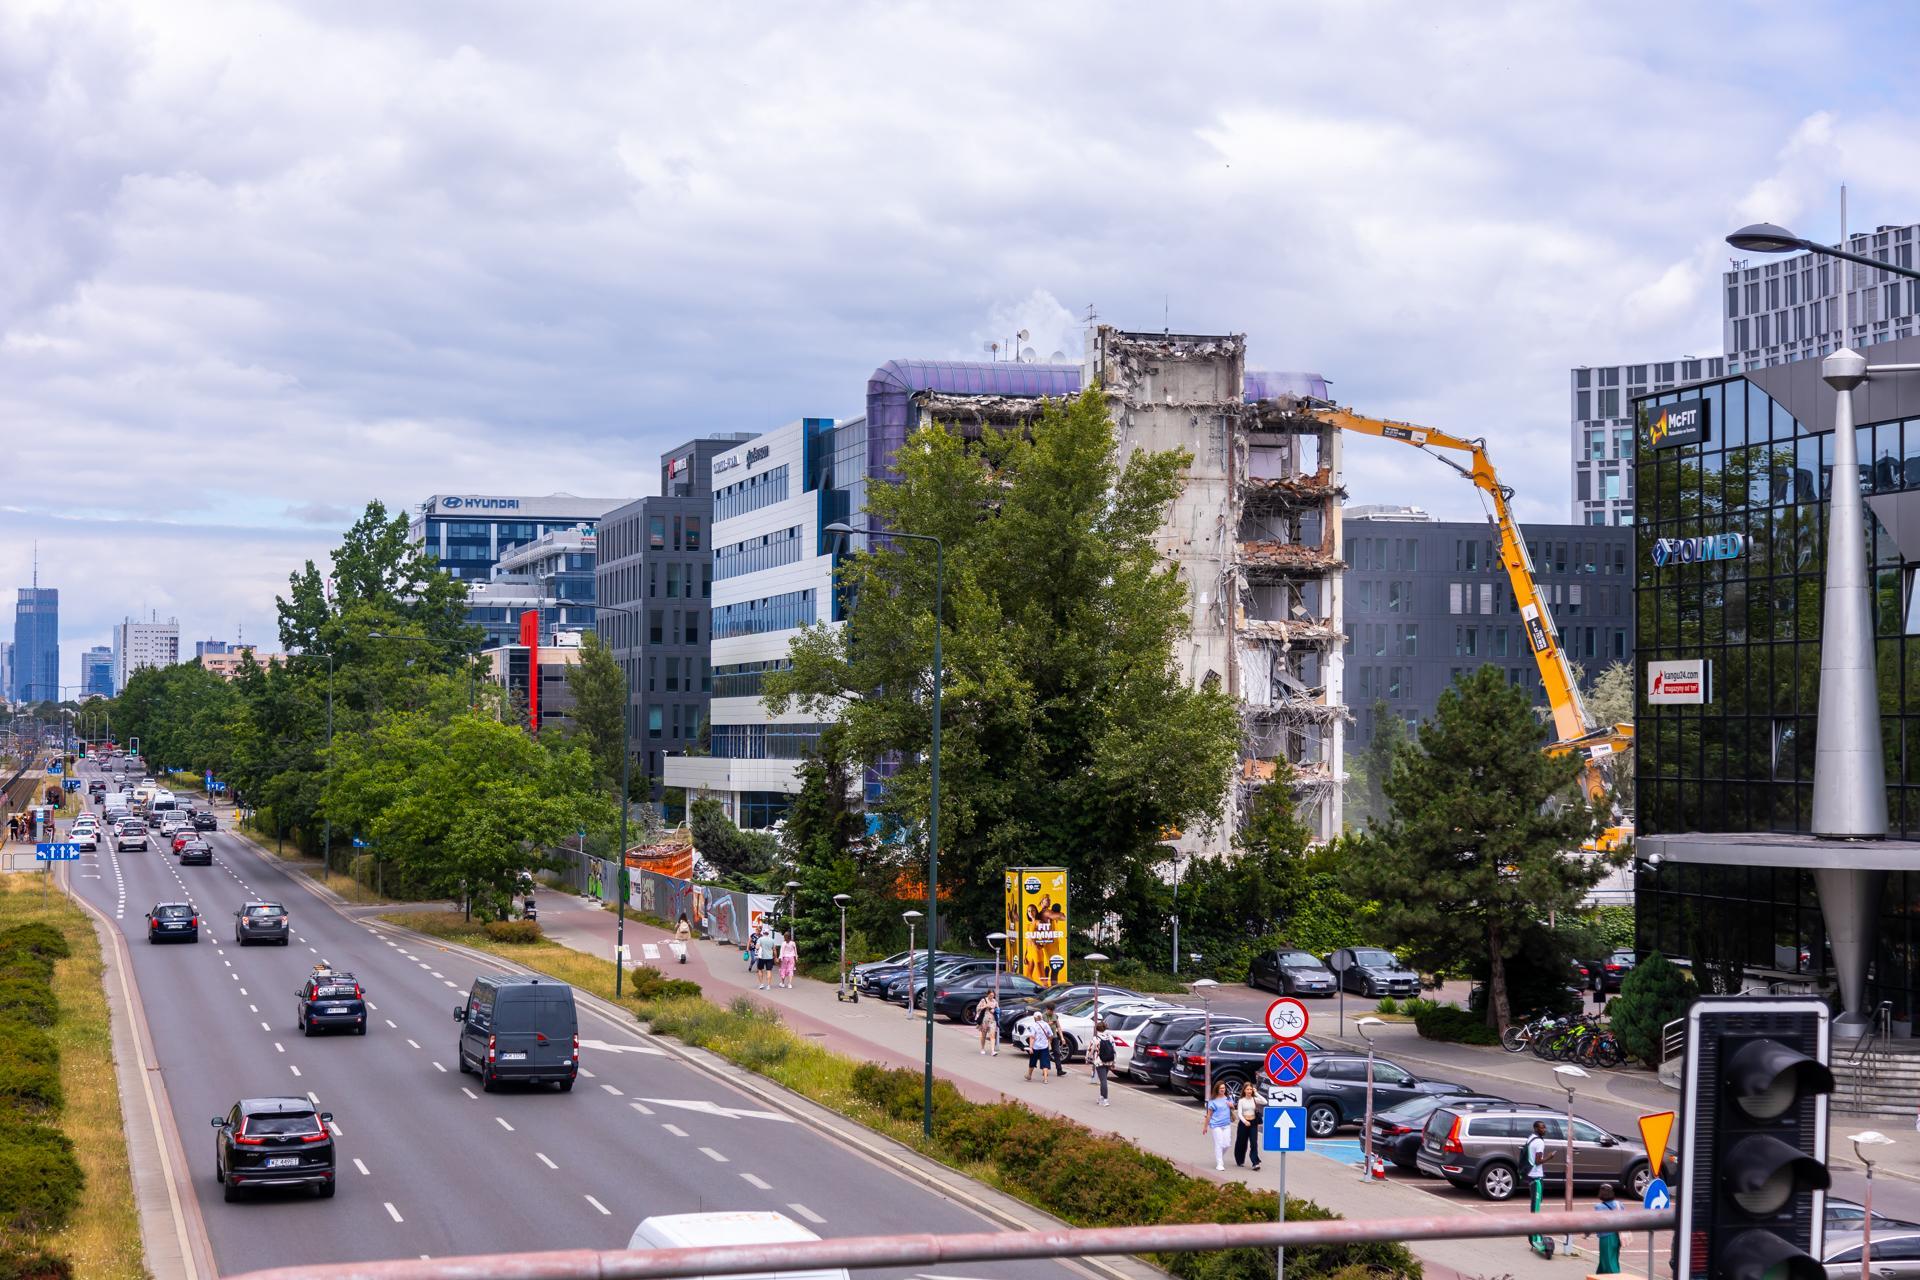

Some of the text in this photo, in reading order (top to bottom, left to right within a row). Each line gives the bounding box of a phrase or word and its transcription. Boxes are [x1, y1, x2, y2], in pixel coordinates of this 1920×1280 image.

[1668, 409, 1697, 428] McFIT
[464, 498, 519, 509] HYUNDAI
[1672, 532, 1741, 563] POLMED
[1038, 923, 1051, 931] FIT
[1025, 931, 1064, 939] SUMMER
